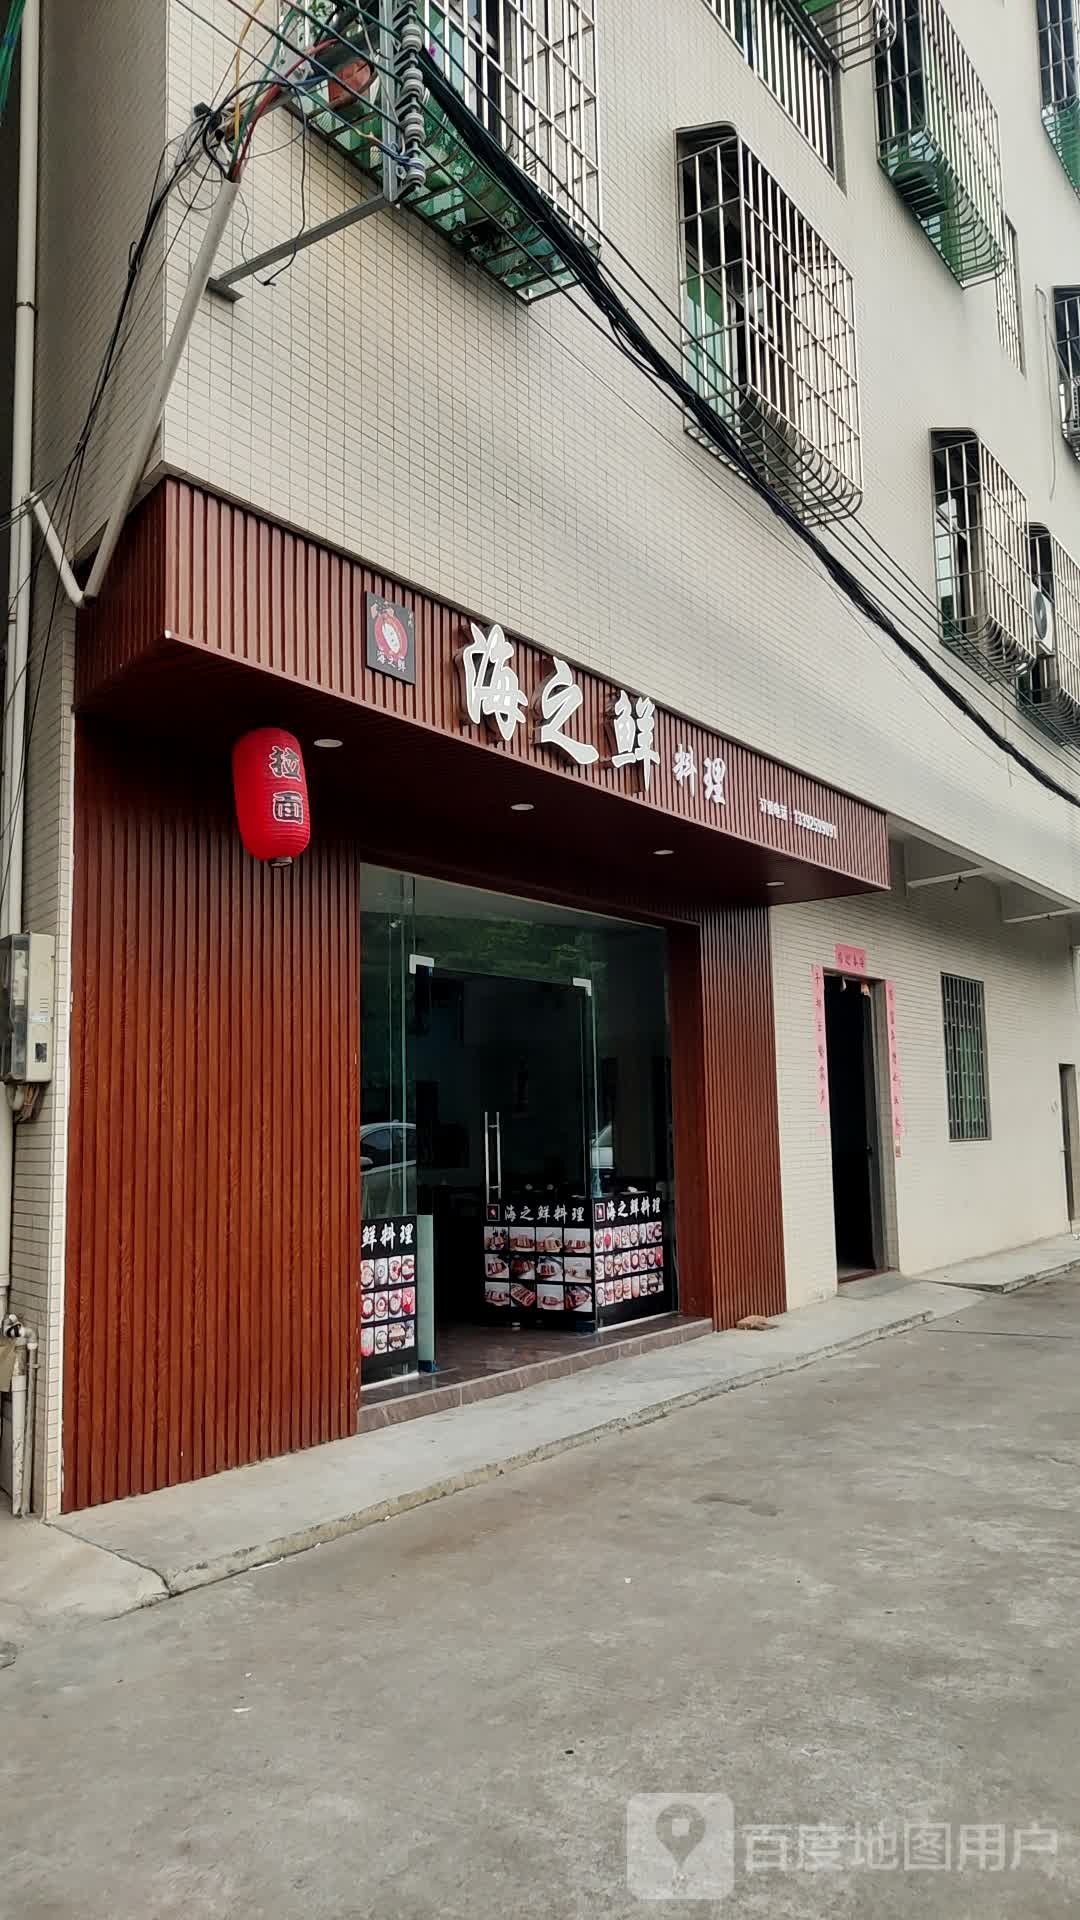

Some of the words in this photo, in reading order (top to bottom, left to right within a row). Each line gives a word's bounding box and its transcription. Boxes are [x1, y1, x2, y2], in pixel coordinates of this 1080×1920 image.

[269, 745, 303, 824] 拉面
[504, 1204, 585, 1224] 海之鲜料理
[606, 1196, 661, 1222] 海之鲜料理
[361, 1222, 414, 1253] 鲜料理
